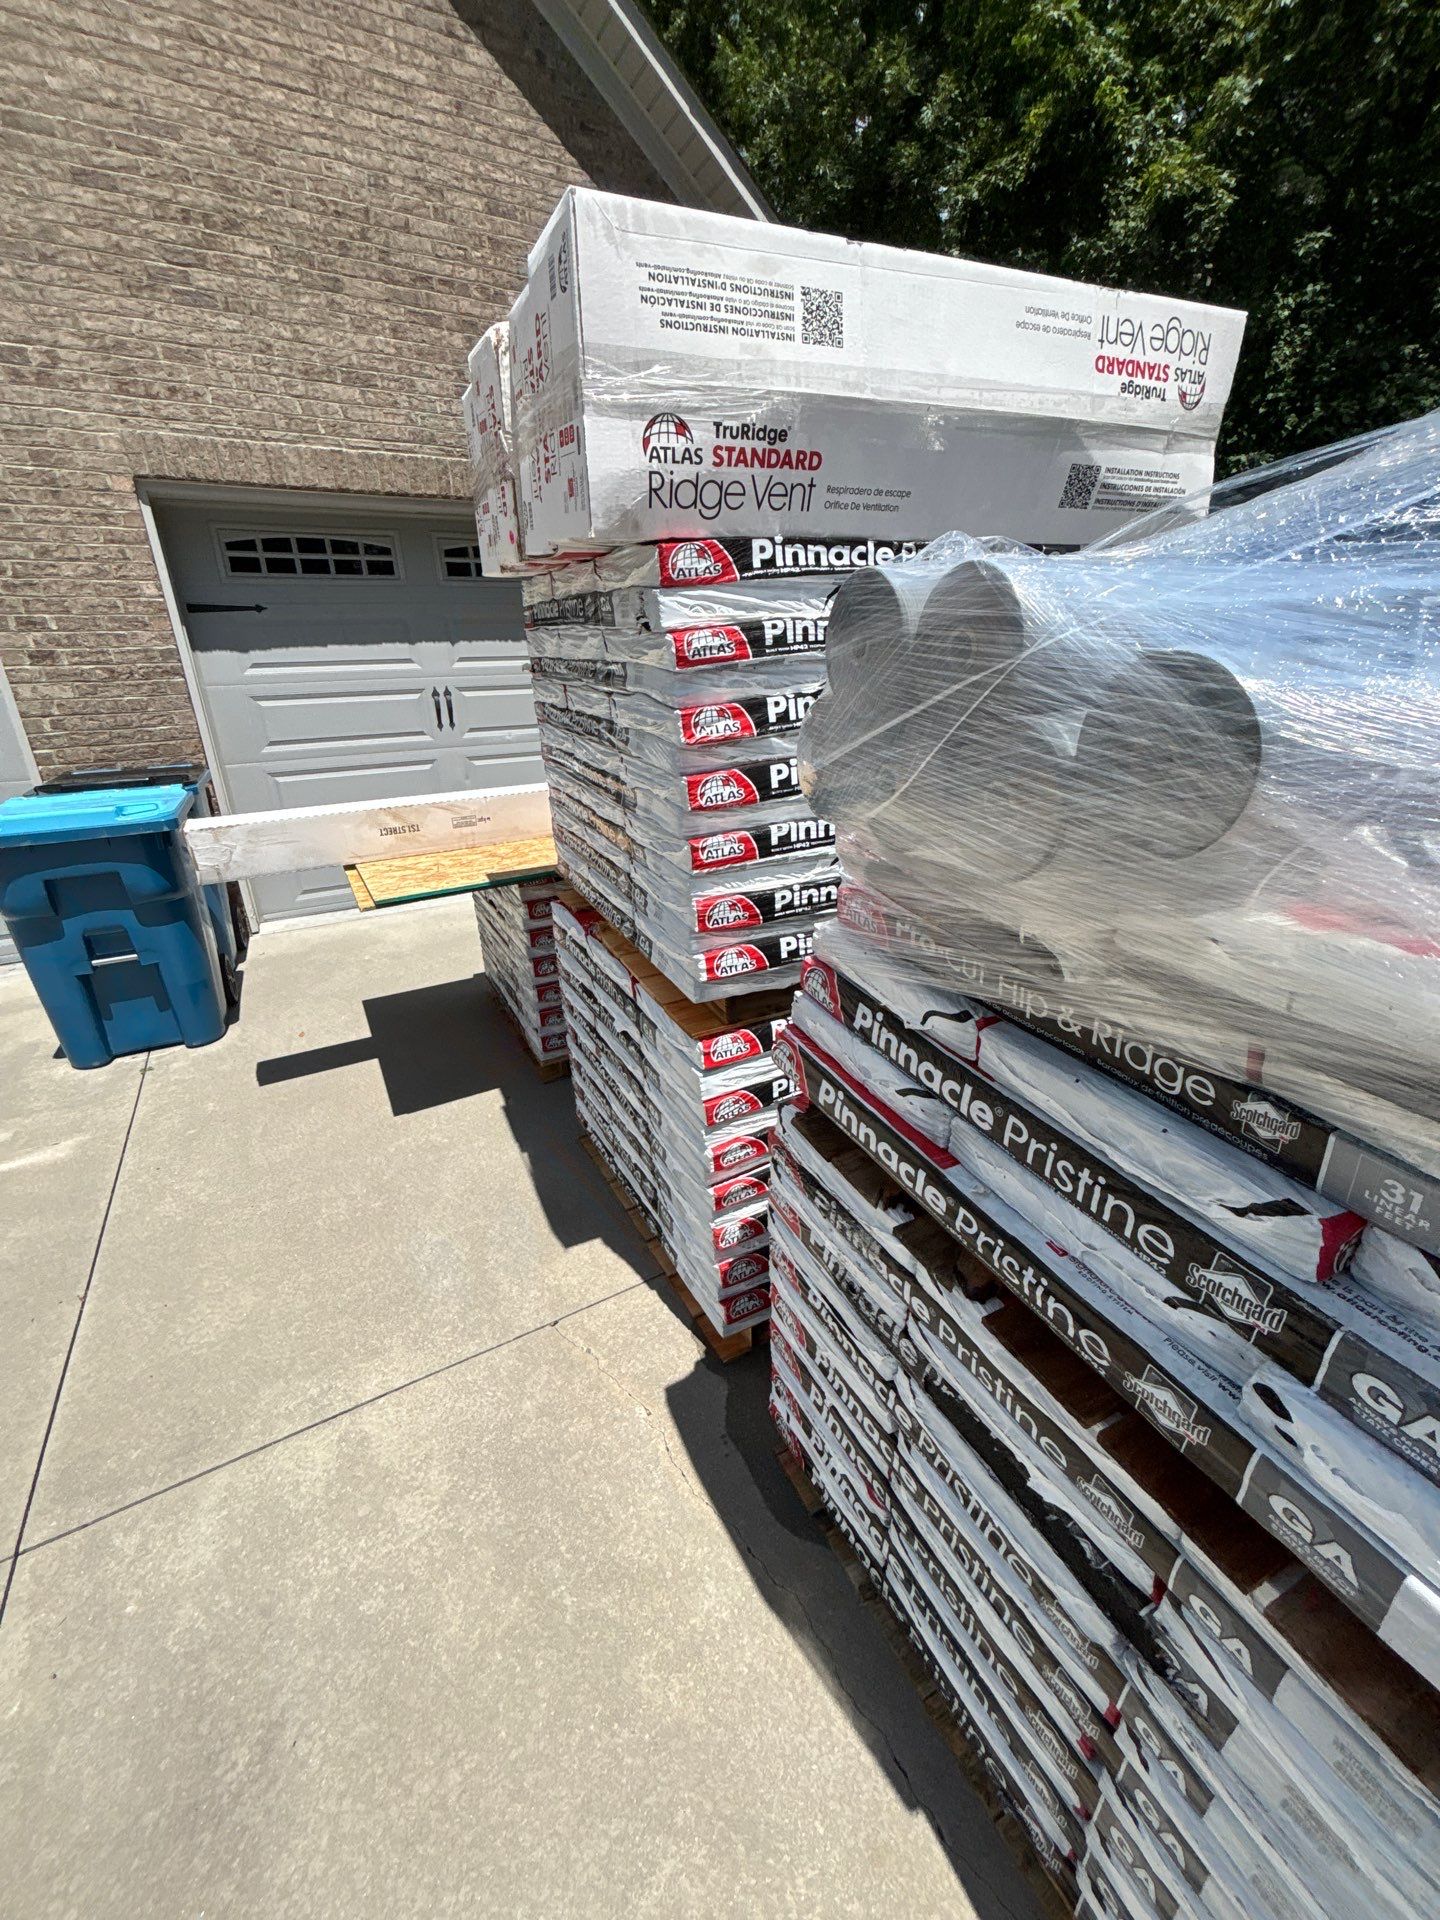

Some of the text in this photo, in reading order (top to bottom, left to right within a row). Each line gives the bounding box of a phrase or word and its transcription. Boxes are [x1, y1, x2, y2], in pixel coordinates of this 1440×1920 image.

[648, 271, 795, 301] INSTRUCTIONS D'INSTALLATION
[640, 293, 795, 322] INSTRUCCIONES DE INSTALACIÓN
[1025, 305, 1060, 320] Ventilation
[1060, 311, 1070, 321] De
[659, 319, 796, 342] INSTALLATION INSTRUCTIONS
[1015, 320, 1091, 340] Respiradero de escape
[1097, 315, 1212, 366] Ridge Vent
[1094, 355, 1171, 383] STANDARD
[1173, 367, 1205, 385] ATLAS
[1119, 380, 1167, 402] TruRidge
[713, 421, 789, 446] TruRidge
[648, 445, 704, 466] ATLAS
[712, 444, 823, 472] STANDARD
[1100, 482, 1144, 492] INSTRUCCIONES
[1144, 485, 1151, 493] DE
[1104, 467, 1143, 476] INSTALLATION
[1143, 469, 1180, 480] INSTRUCTIONS
[648, 471, 816, 520] Ridge Vent
[824, 500, 899, 512] Orifice De Ventilation
[826, 485, 912, 500] Respiradero de escape
[676, 563, 722, 578] ATLAS
[751, 534, 895, 569] Pinnacle
[691, 641, 735, 659] ATLAS
[699, 721, 741, 736] ATLAS
[703, 788, 744, 806] ATLAS
[704, 845, 744, 861] ATLAS
[708, 912, 749, 927] ATLAS
[719, 960, 756, 976] ATLAS
[715, 1044, 750, 1061] ATLAS
[999, 976, 1049, 1019] Hip
[1057, 1005, 1082, 1038] &
[1091, 1018, 1217, 1106] Ridge
[717, 1104, 751, 1123] ATLAS
[805, 984, 834, 1012] ATLAS
[1002, 1113, 1175, 1265] Pristine
[1230, 1099, 1300, 1140] Scotchgard
[723, 1148, 756, 1164] ATLAS
[724, 1188, 759, 1205] ATLAS
[1364, 1189, 1431, 1231] LINEAR
[1380, 1179, 1424, 1215] 31
[1375, 1206, 1415, 1231] FEET
[723, 1230, 757, 1247] ATLAS
[731, 1266, 763, 1283] ATLAS
[955, 1207, 1112, 1368] Pristine
[732, 1300, 765, 1318] ATLAS
[1185, 1262, 1288, 1334] Scotchgard
[1163, 1336, 1199, 1368] Please
[938, 1326, 1067, 1471] Pristine
[1121, 1370, 1211, 1447] Scotchgard
[807, 1288, 1034, 1587] Pinnacle Pristine
[814, 1346, 1035, 1657] Pinnacle Pristine
[1076, 1475, 1145, 1550] Scotchgard
[809, 1382, 1019, 1699] Pinnacle Pristine
[1268, 1492, 1360, 1589] GA
[811, 1429, 1011, 1746] Pinnacle Pristine
[1188, 1594, 1254, 1677] GA
[1134, 1716, 1188, 1798] GA
[1134, 1789, 1187, 1870] GA
[1109, 1826, 1157, 1904] GA
